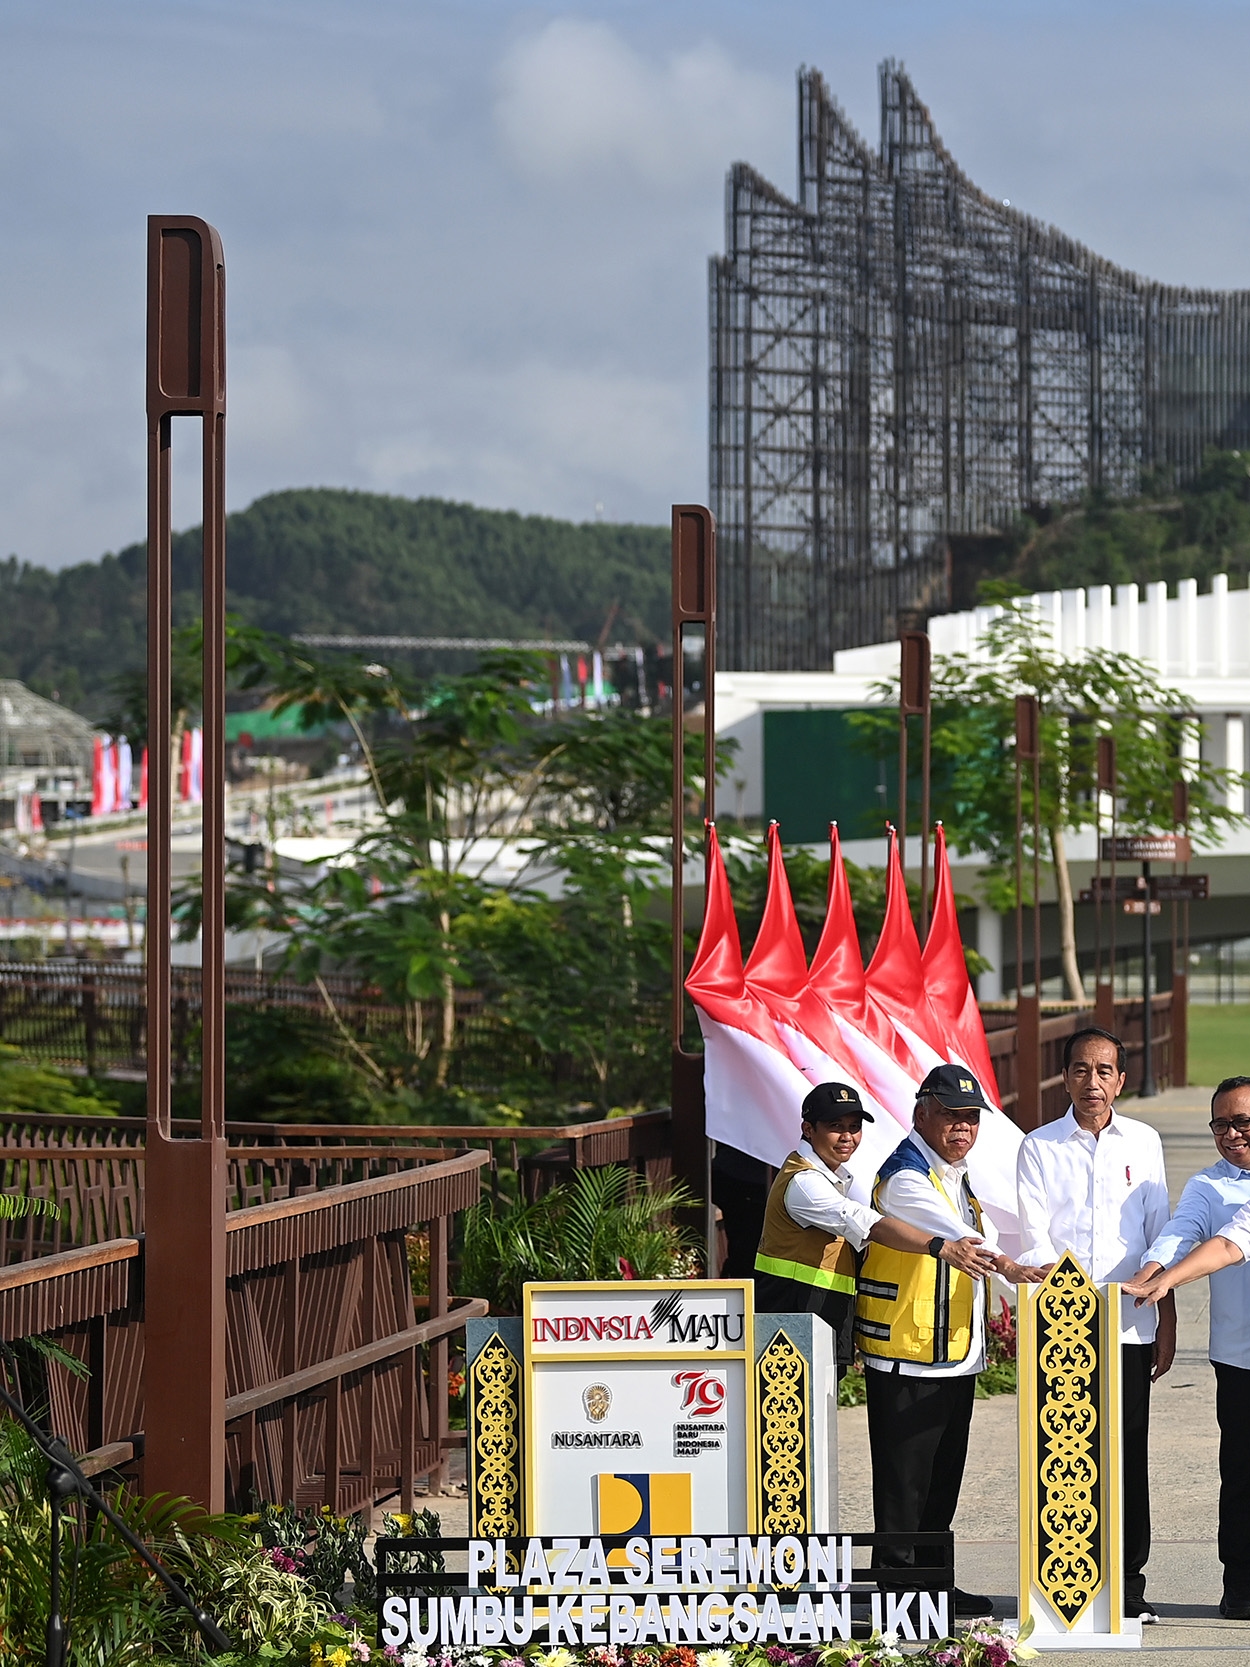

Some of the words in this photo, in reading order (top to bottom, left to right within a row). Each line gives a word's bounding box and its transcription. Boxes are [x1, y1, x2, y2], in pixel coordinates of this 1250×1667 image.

[532, 1315, 654, 1342] INDONESIA
[667, 1313, 745, 1350] MAJU
[674, 1370, 725, 1417] 79
[554, 1433, 642, 1447] NUSANTARA
[676, 1431, 699, 1439] BARU
[676, 1440, 720, 1448] INDONESIA
[468, 1537, 612, 1588] PLAZA
[623, 1535, 853, 1586] SEREMONI
[381, 1596, 533, 1646] SUMBU
[548, 1592, 852, 1644] KEBANGSAAN
[871, 1591, 949, 1641] IKN
